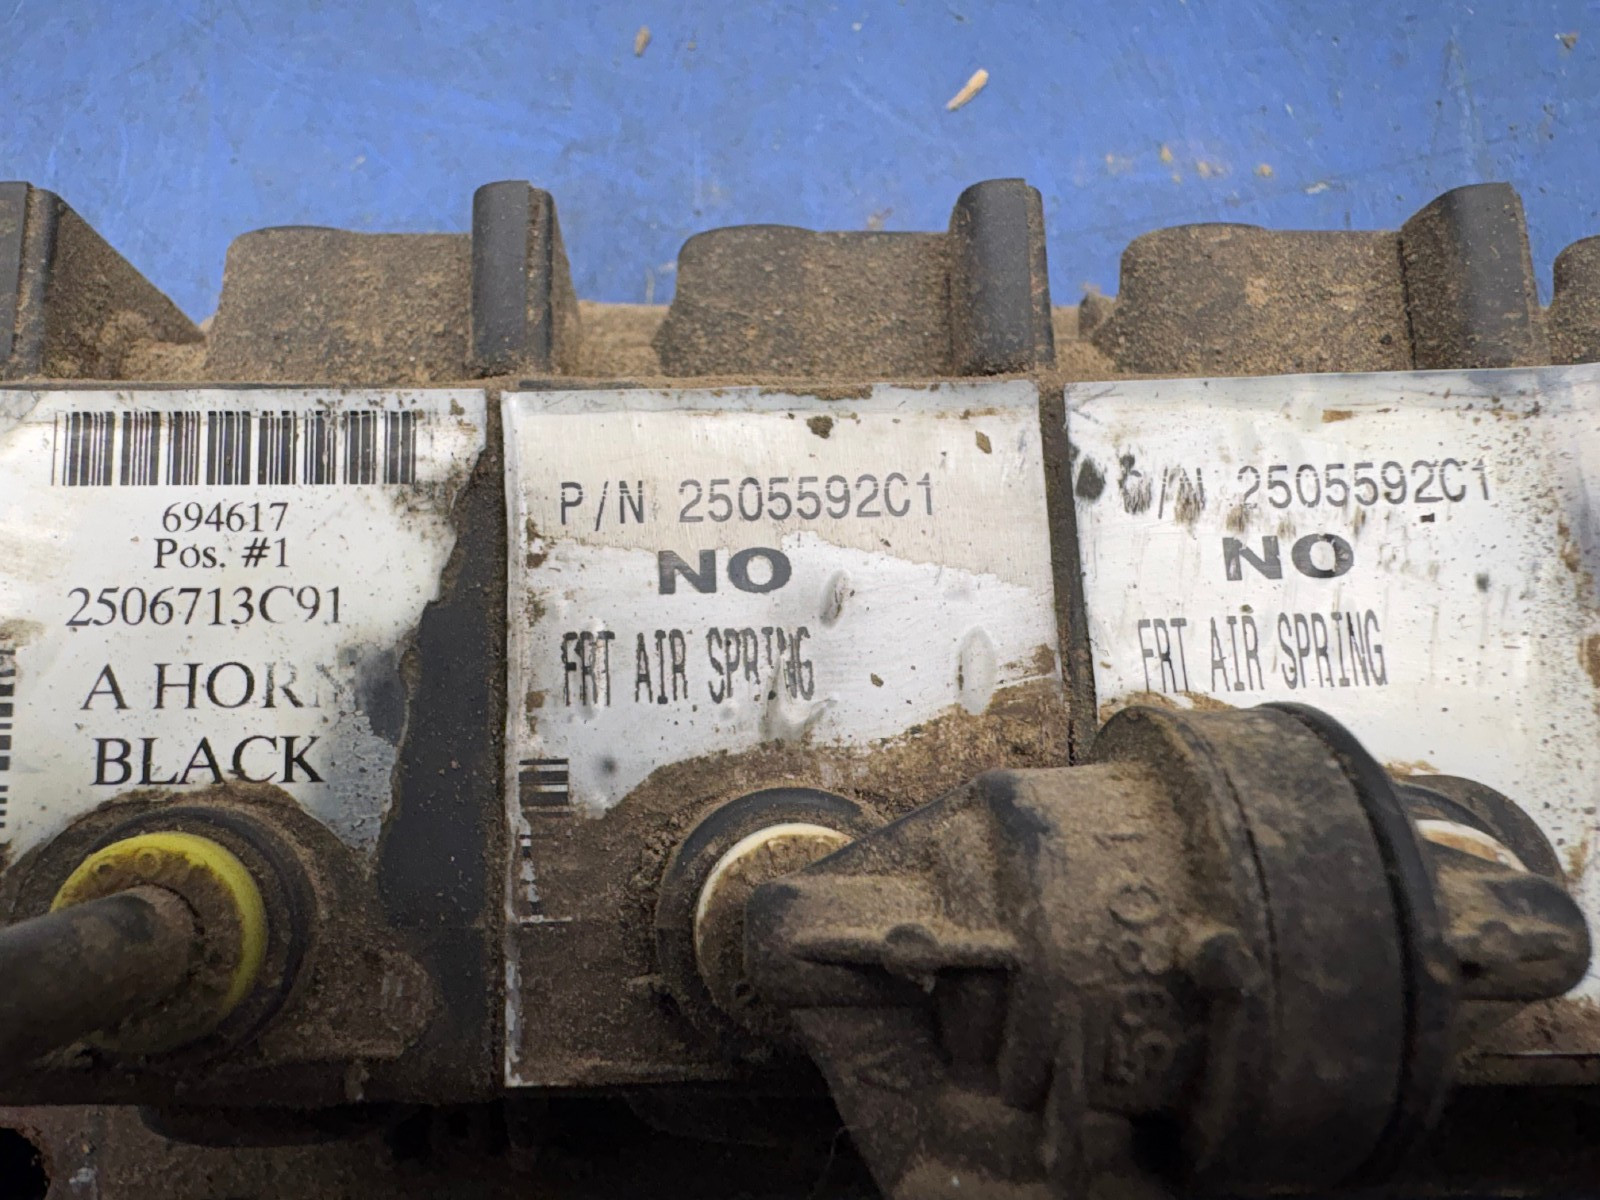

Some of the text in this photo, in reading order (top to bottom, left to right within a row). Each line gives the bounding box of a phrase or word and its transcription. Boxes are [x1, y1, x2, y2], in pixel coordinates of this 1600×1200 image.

[561, 472, 934, 531] P/N 2505592C1
[1237, 458, 1491, 509] 2505592C1
[162, 502, 288, 532] 694617
[153, 537, 290, 568] Pos. #1
[657, 547, 792, 595] NO
[1222, 533, 1354, 581] NO
[65, 586, 341, 627] 2506713C91
[561, 626, 815, 706] FRT AIR SPRING
[1138, 610, 1388, 693] FRT AIR SPRING
[80, 665, 130, 710] A
[90, 735, 325, 785] BLACK
